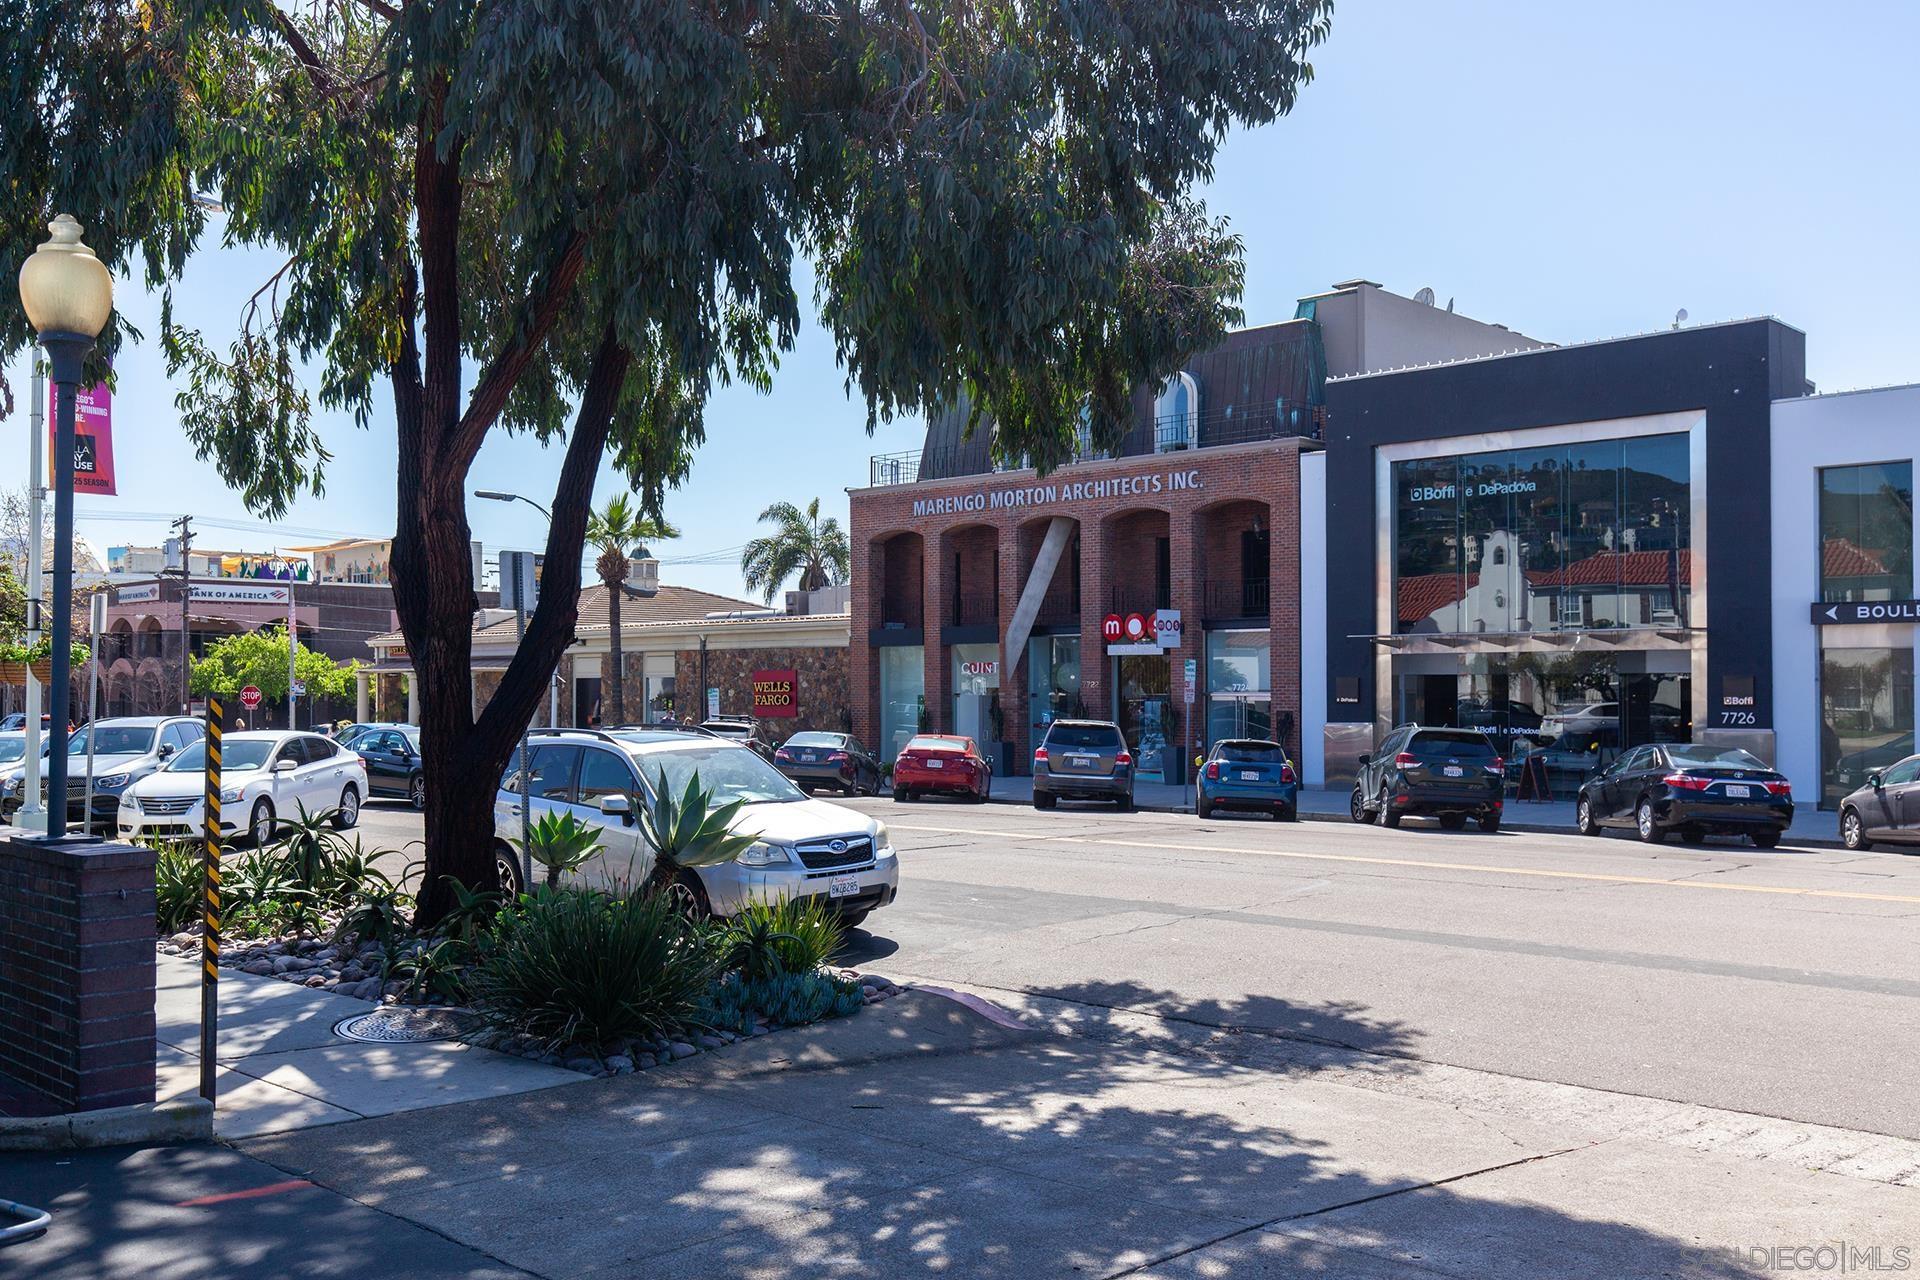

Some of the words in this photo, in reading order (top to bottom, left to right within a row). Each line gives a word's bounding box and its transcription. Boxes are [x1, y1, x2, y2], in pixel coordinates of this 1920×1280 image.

[76, 393, 95, 405] EGO'S
[73, 461, 94, 470] USE
[83, 478, 110, 487] SEASON
[913, 494, 985, 516] MARENGO
[990, 486, 1057, 509] MORTON
[1061, 475, 1162, 502] ARCHITECTS
[1168, 470, 1204, 491] INC.
[1423, 485, 1456, 500] Boffi
[1479, 481, 1537, 496] DePadova
[189, 590, 213, 599] BANK
[216, 591, 227, 599] OF
[229, 590, 268, 600] AMERICA
[753, 681, 791, 693] WELLS
[242, 691, 260, 700] STOP
[754, 694, 790, 706] FARGO
[1732, 696, 1754, 705] Boffi
[1721, 712, 1756, 724] 7726
